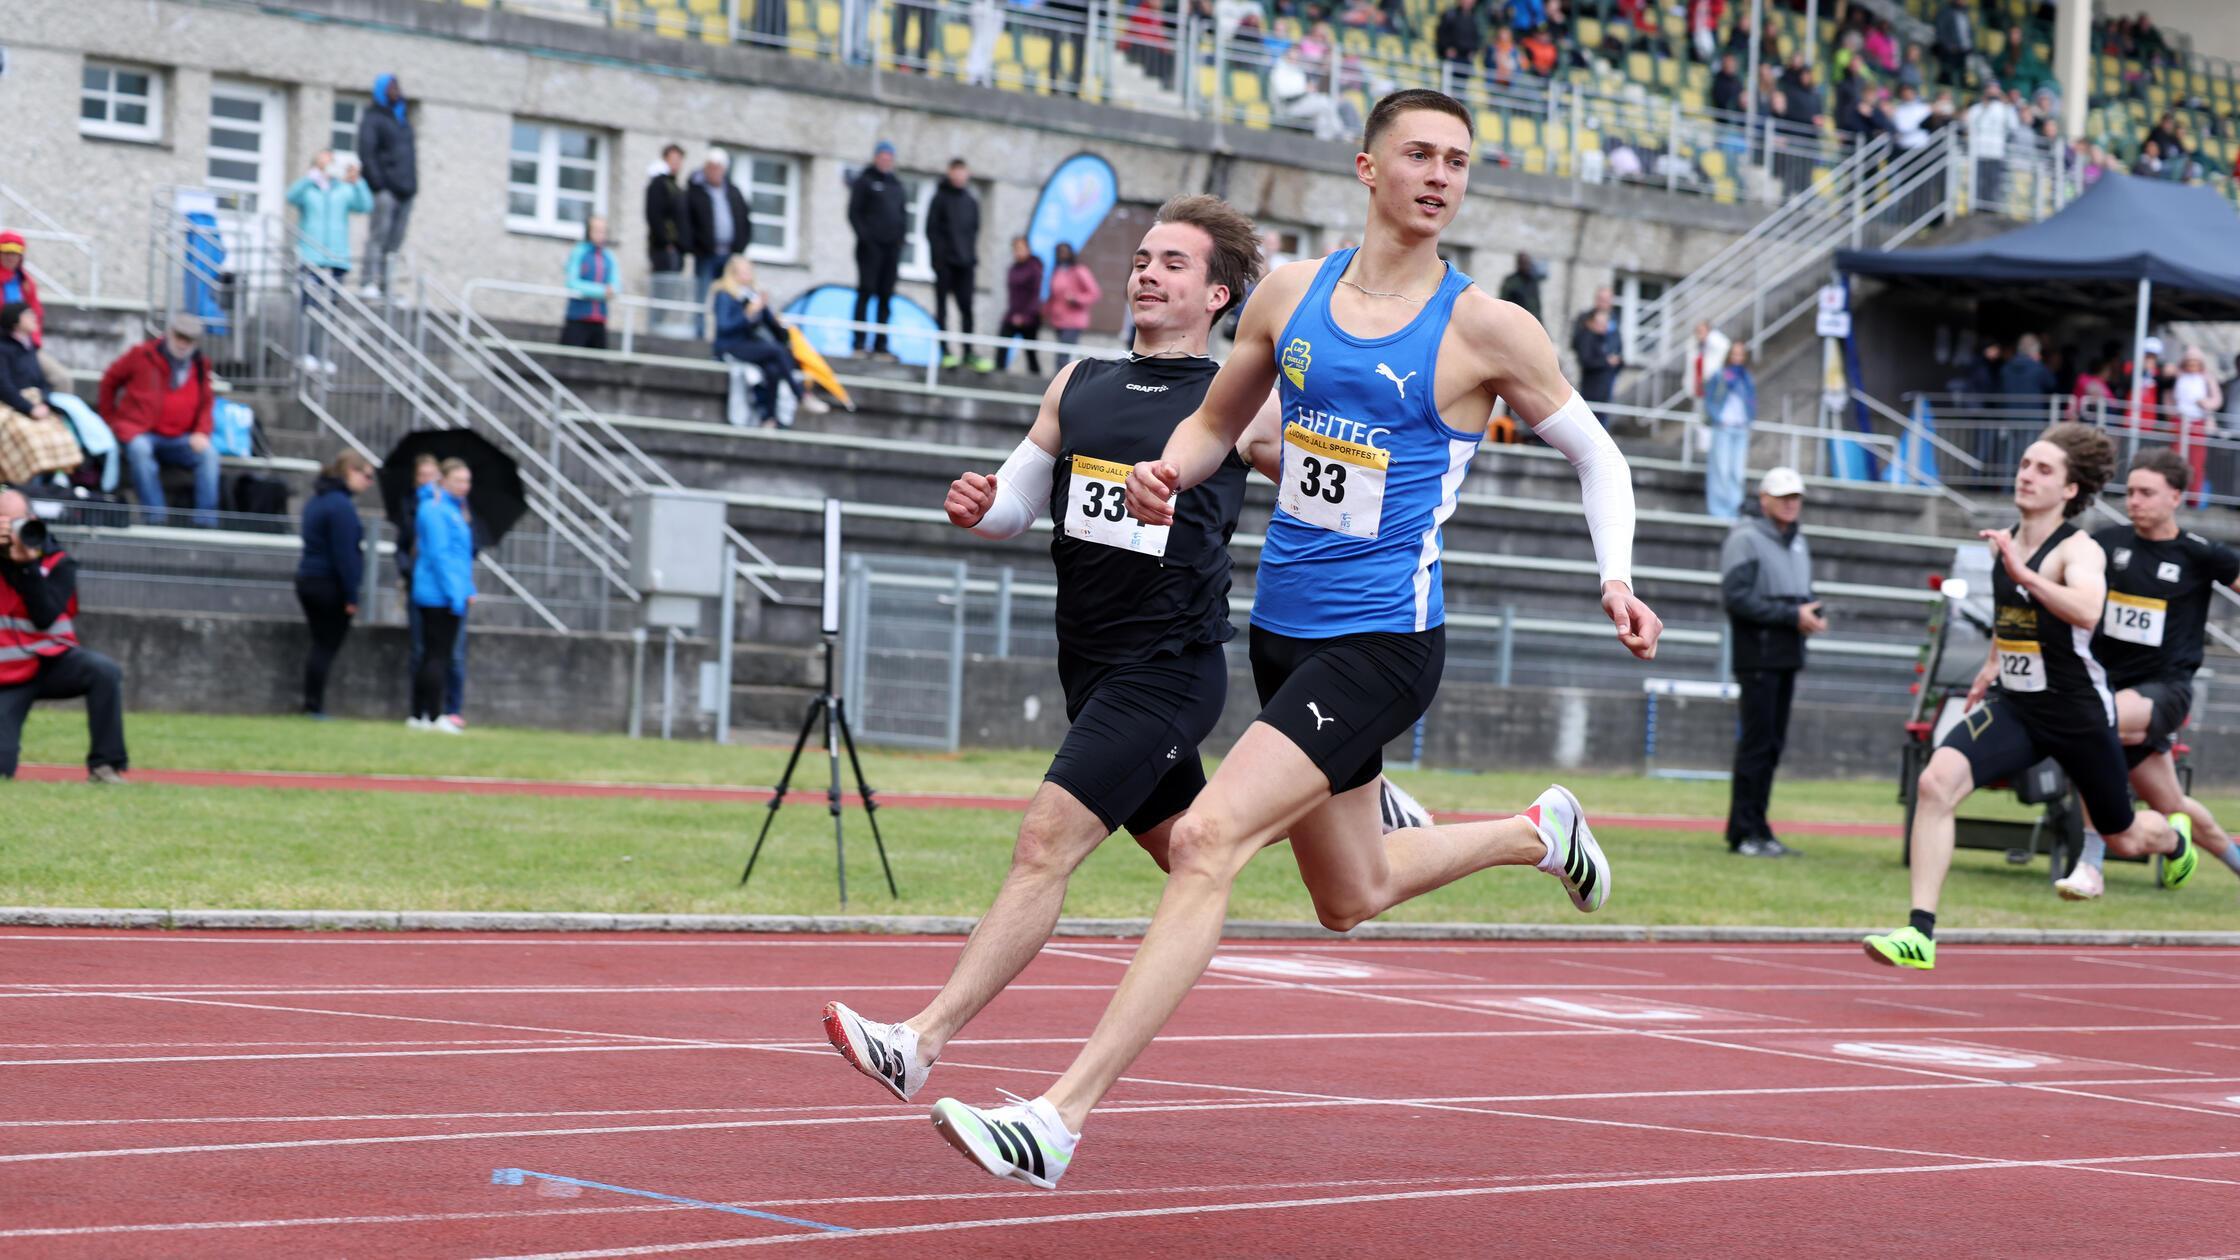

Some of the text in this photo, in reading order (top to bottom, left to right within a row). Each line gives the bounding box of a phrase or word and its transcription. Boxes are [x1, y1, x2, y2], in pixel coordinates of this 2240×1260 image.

[1126, 383, 1161, 393] CRAFT
[1289, 429, 1377, 460] LUDWIG JALL SPORTFEST
[1078, 461, 1105, 473] LUDWIG
[1105, 466, 1124, 477] JALL
[1300, 456, 1347, 504] 33
[1082, 481, 1146, 527] 33
[2115, 606, 2152, 630] 126
